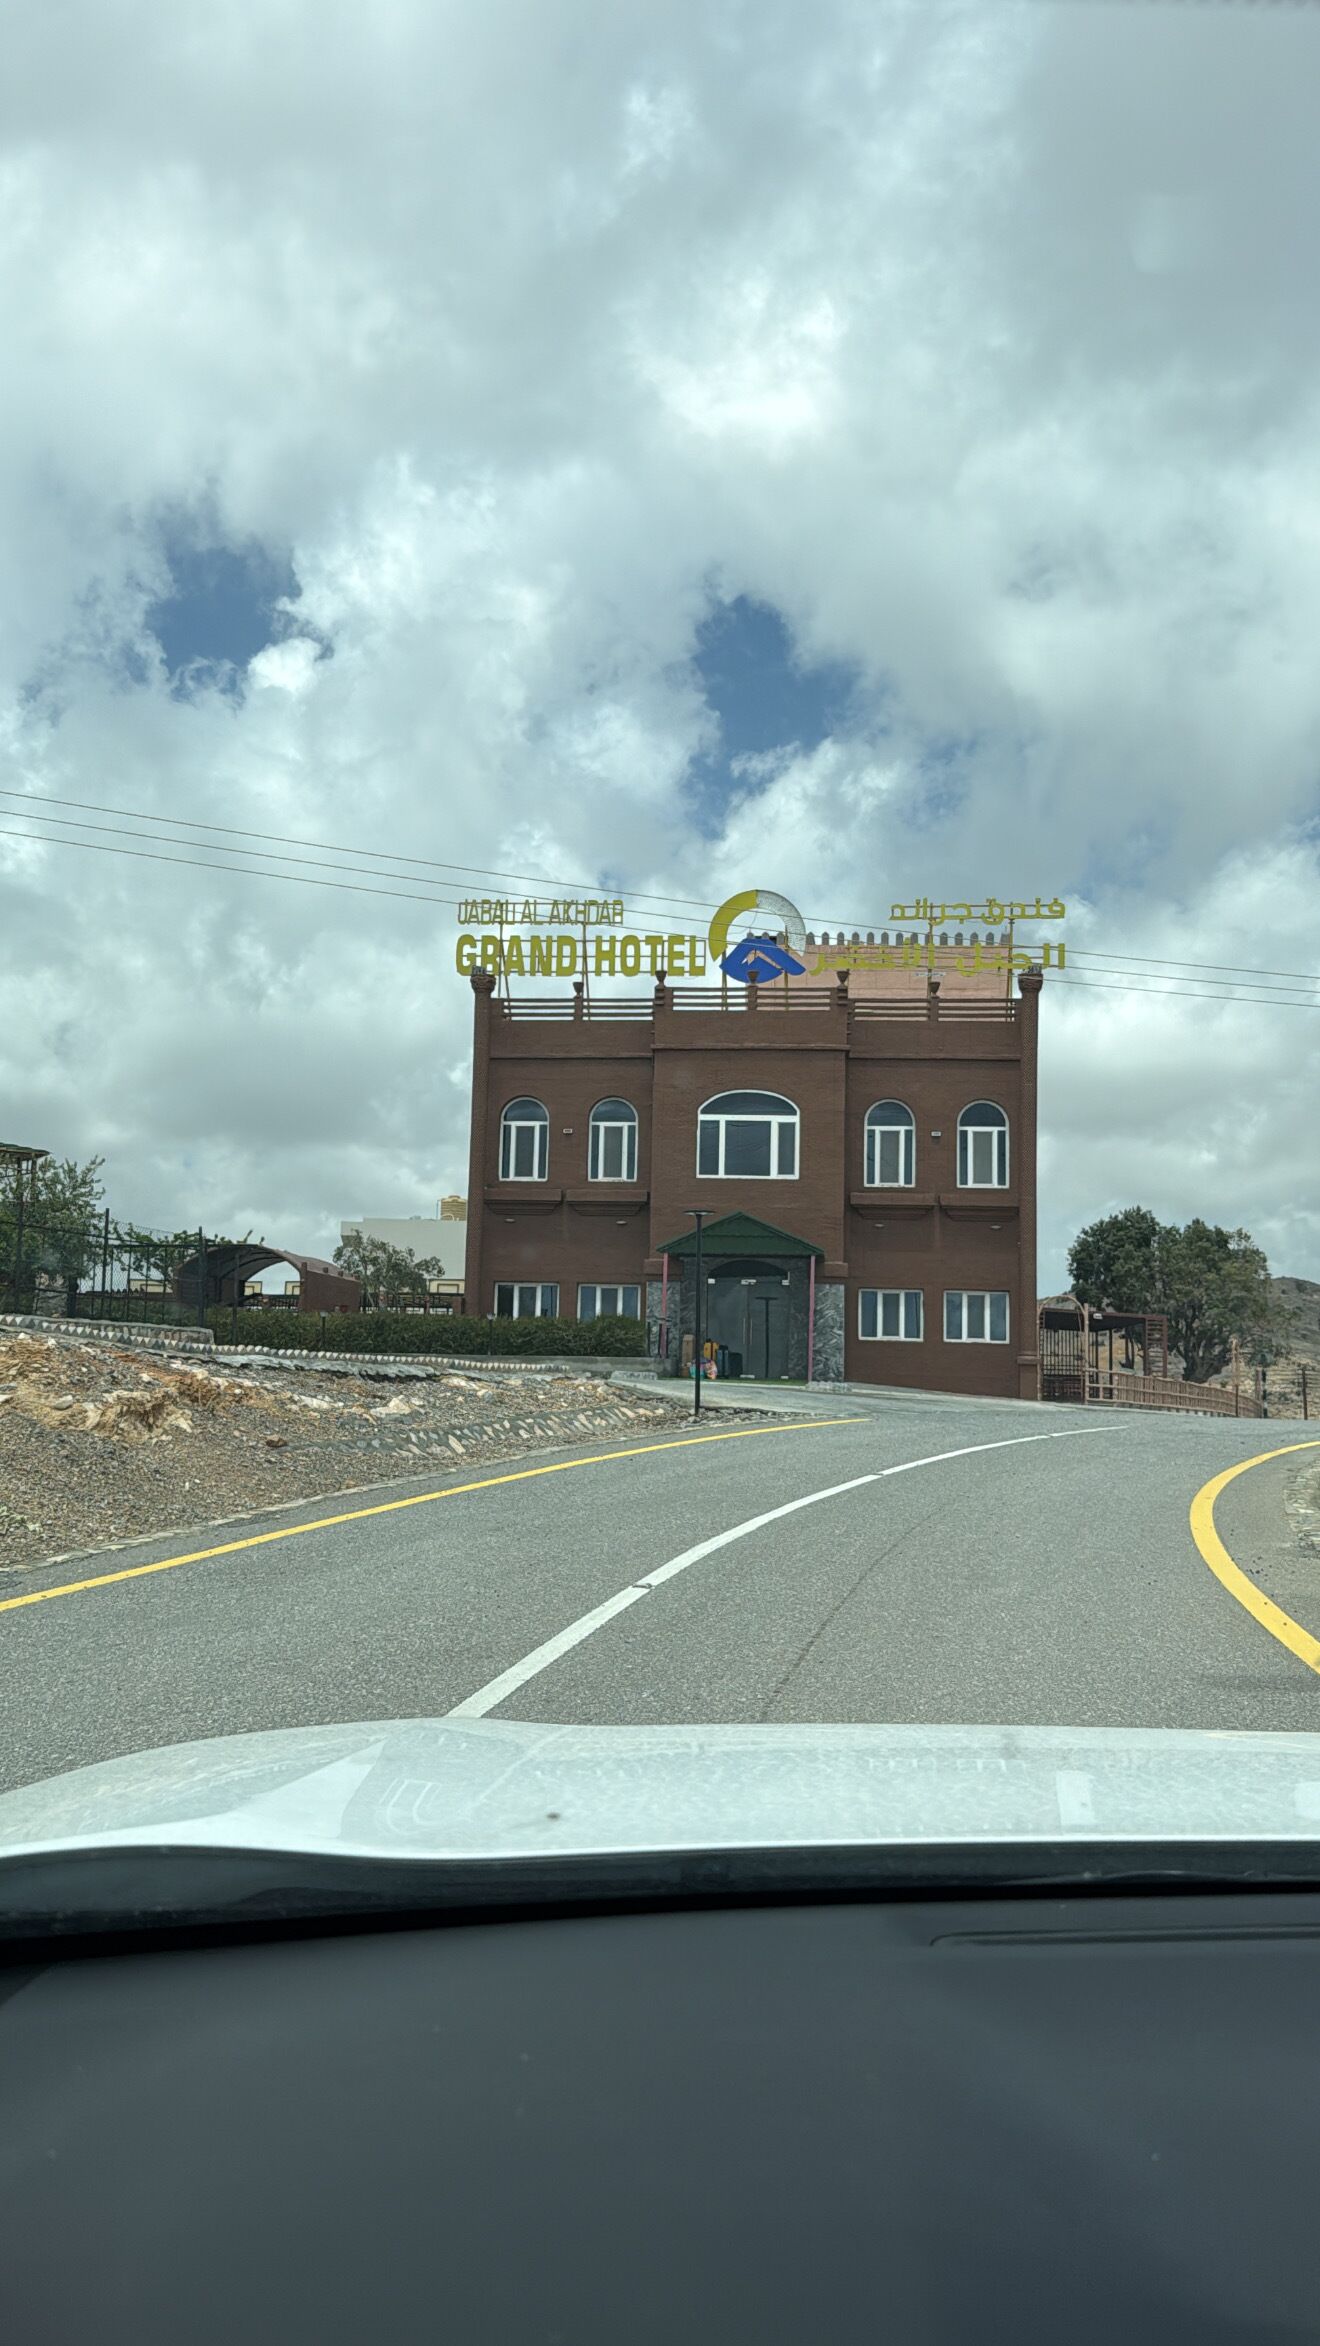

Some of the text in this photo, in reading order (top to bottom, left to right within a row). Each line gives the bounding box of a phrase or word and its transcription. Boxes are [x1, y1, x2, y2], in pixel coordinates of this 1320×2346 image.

[457, 899, 624, 926] JABAL AL AKHDAR
[888, 897, 1066, 926] فندق جراند
[456, 934, 706, 977] GRAND HOTEL
[956, 942, 1066, 977] الجبل
